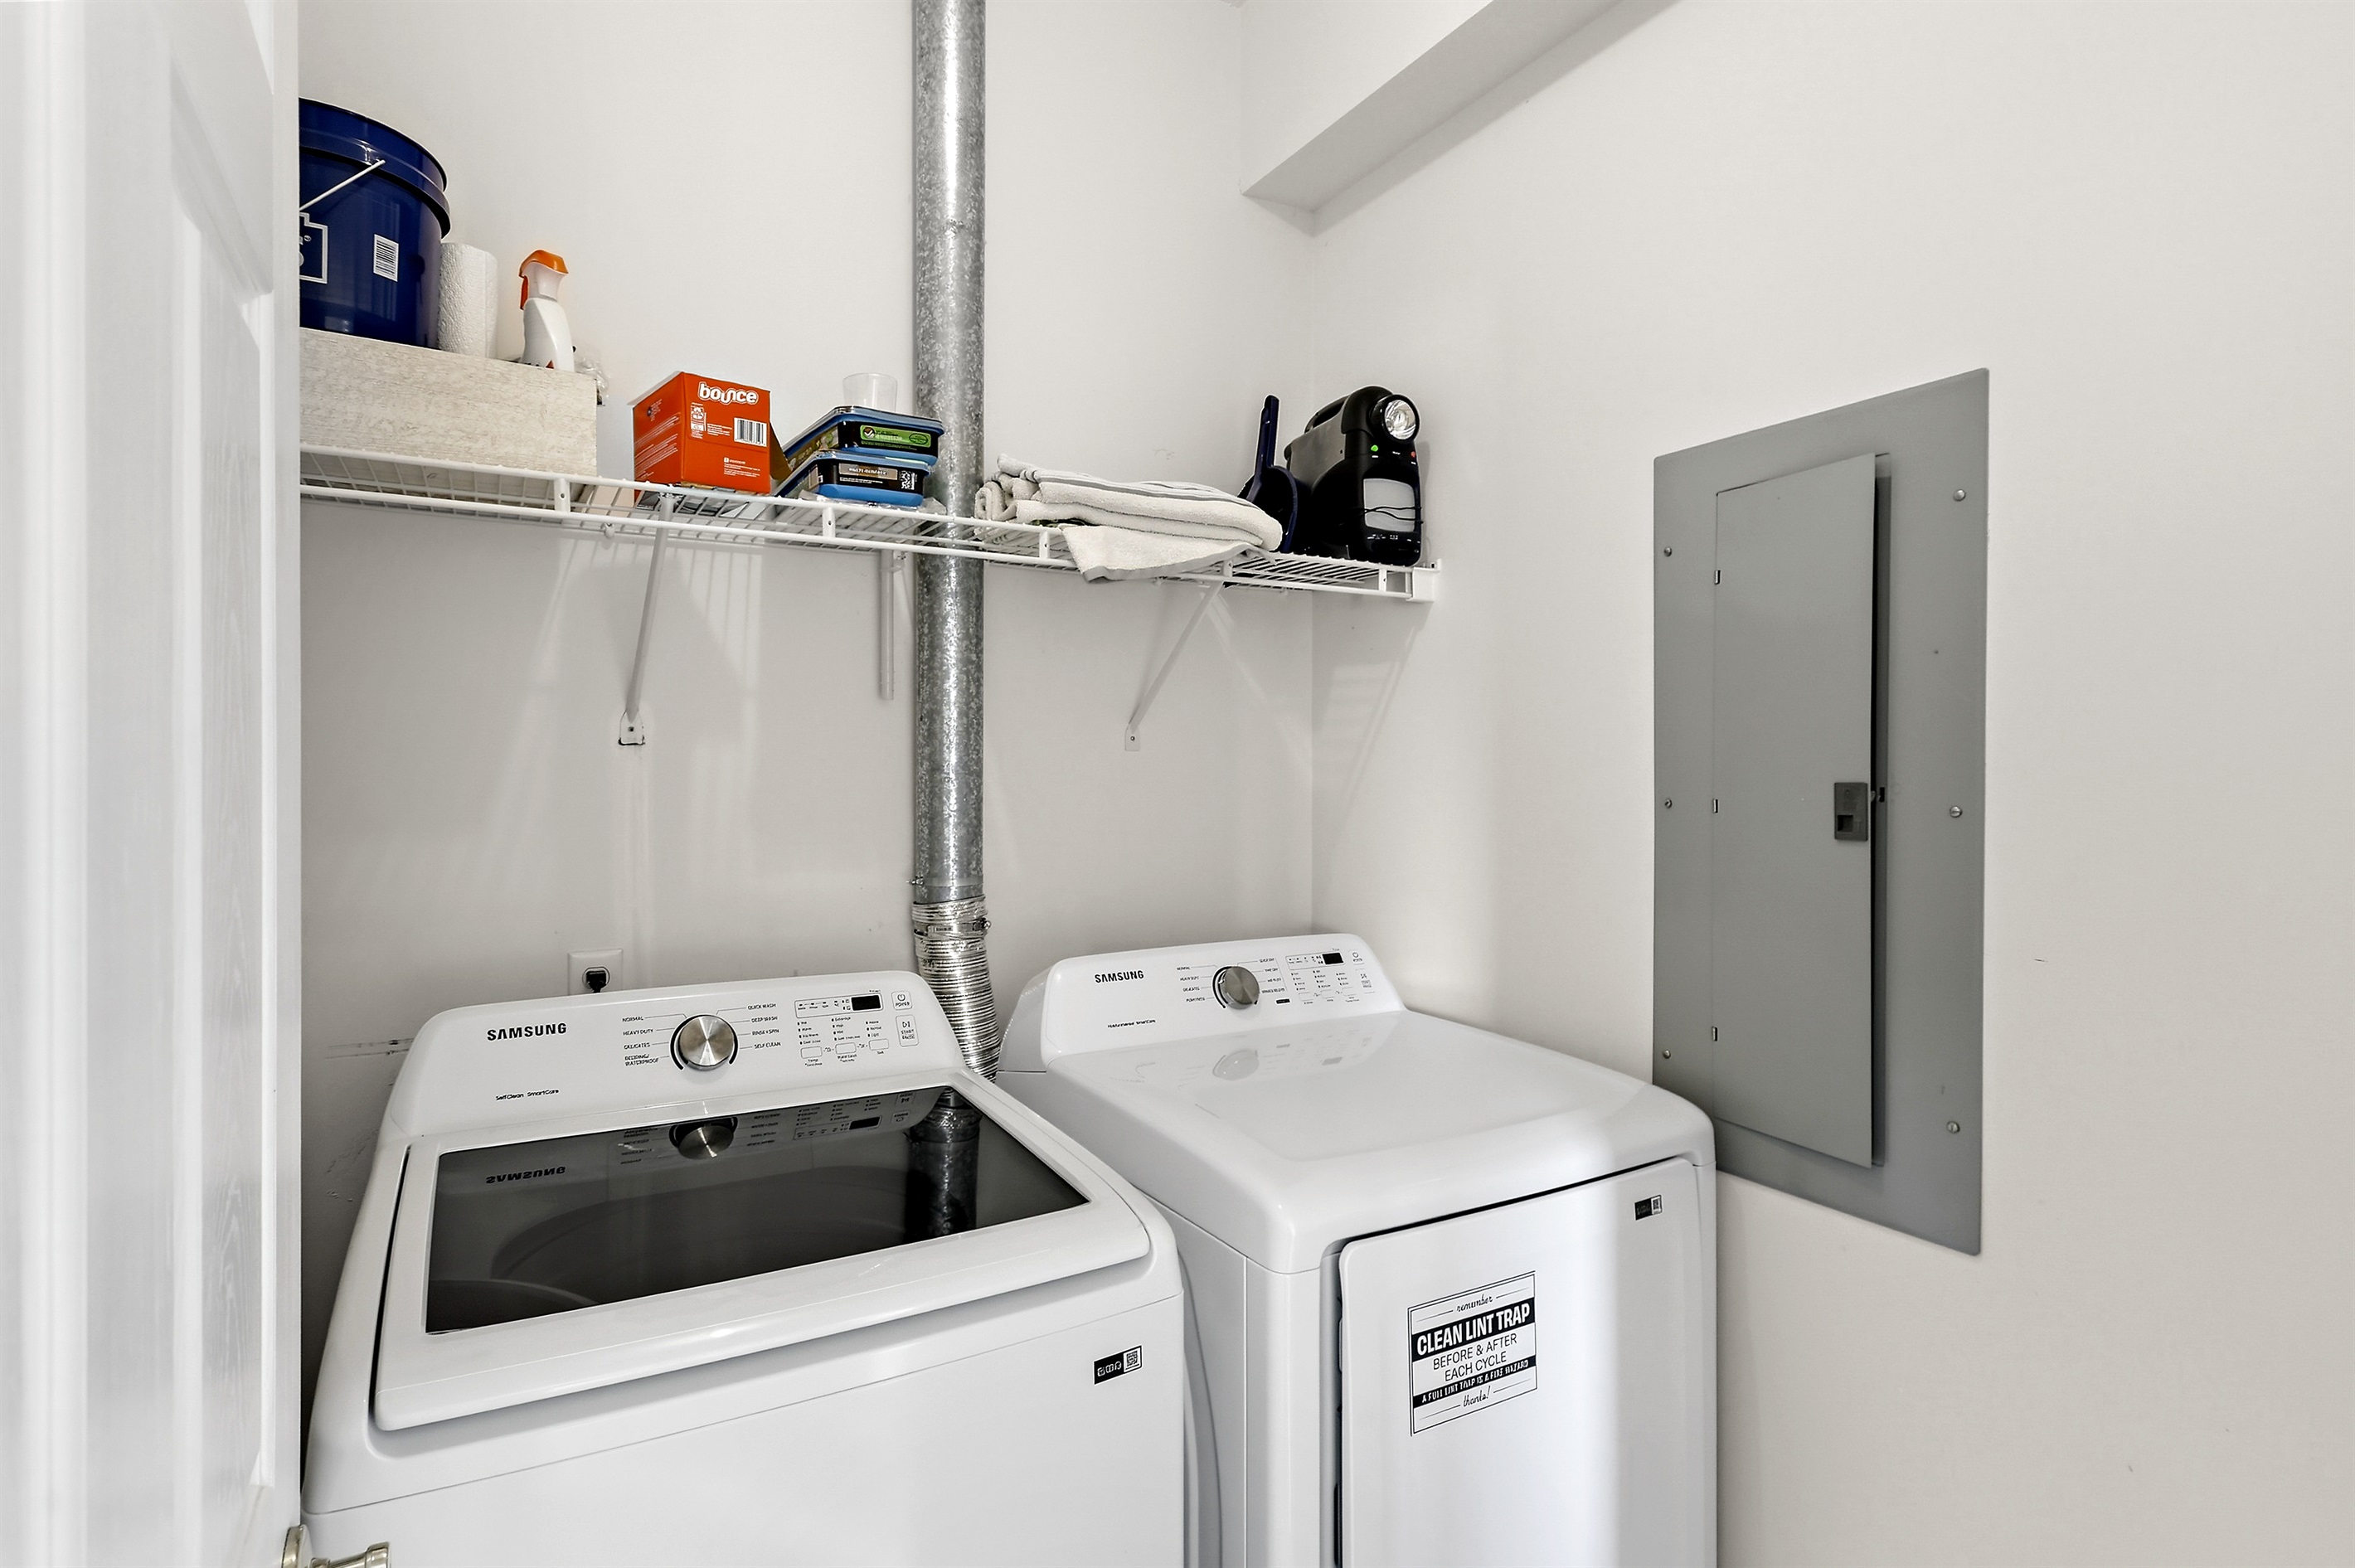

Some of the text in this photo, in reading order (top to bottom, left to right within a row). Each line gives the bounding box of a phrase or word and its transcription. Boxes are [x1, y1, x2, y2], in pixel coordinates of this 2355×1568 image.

[698, 382, 758, 405] bounce
[1095, 970, 1144, 983] SAMSUNG
[487, 1022, 566, 1041] SAMSUNG
[1456, 1294, 1493, 1312] remember
[1416, 1303, 1530, 1356] CLEAN LINT TRAP
[1433, 1333, 1517, 1370] BEFORE & AFTER
[1445, 1351, 1508, 1381] EACH CYCLE
[1428, 1391, 1443, 1401] FULL
[1445, 1385, 1459, 1396] LINT
[1459, 1379, 1475, 1390] TRAP
[1477, 1376, 1483, 1384] IS
[1463, 1386, 1491, 1407] thanks!
